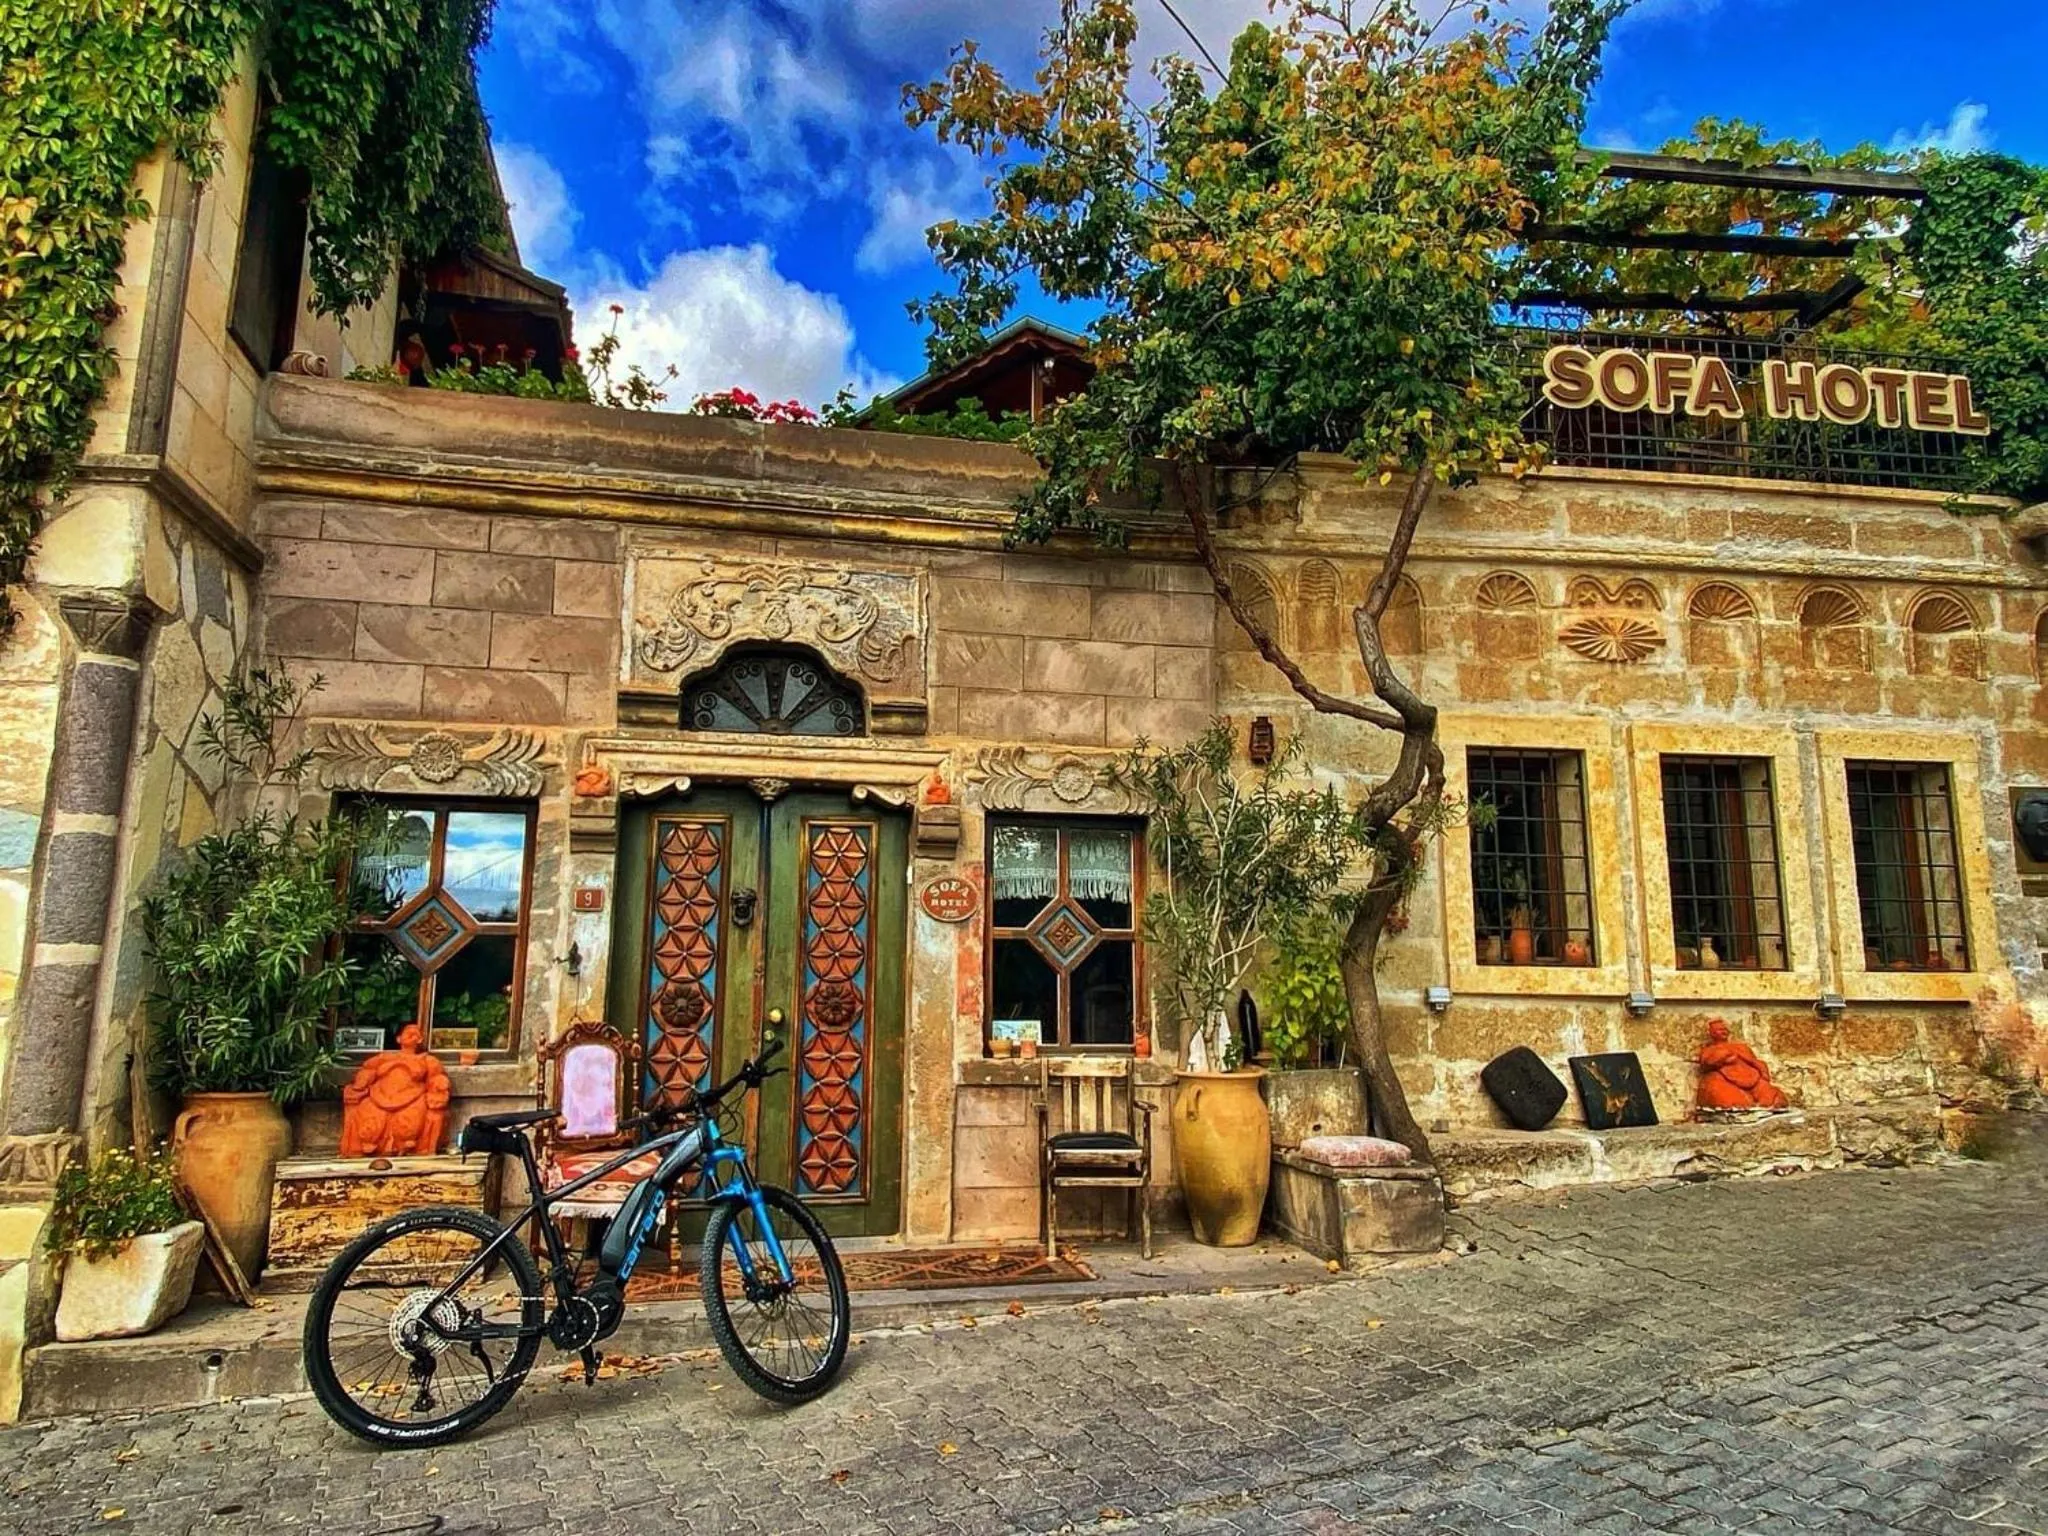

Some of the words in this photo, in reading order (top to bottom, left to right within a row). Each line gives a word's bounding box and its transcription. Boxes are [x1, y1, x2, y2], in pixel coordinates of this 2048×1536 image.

[1543, 345, 1743, 419] SOFA
[1762, 359, 1990, 436] HOTEL
[929, 881, 970, 898] SOFA
[584, 892, 592, 906] 9
[930, 898, 968, 907] HOTEL
